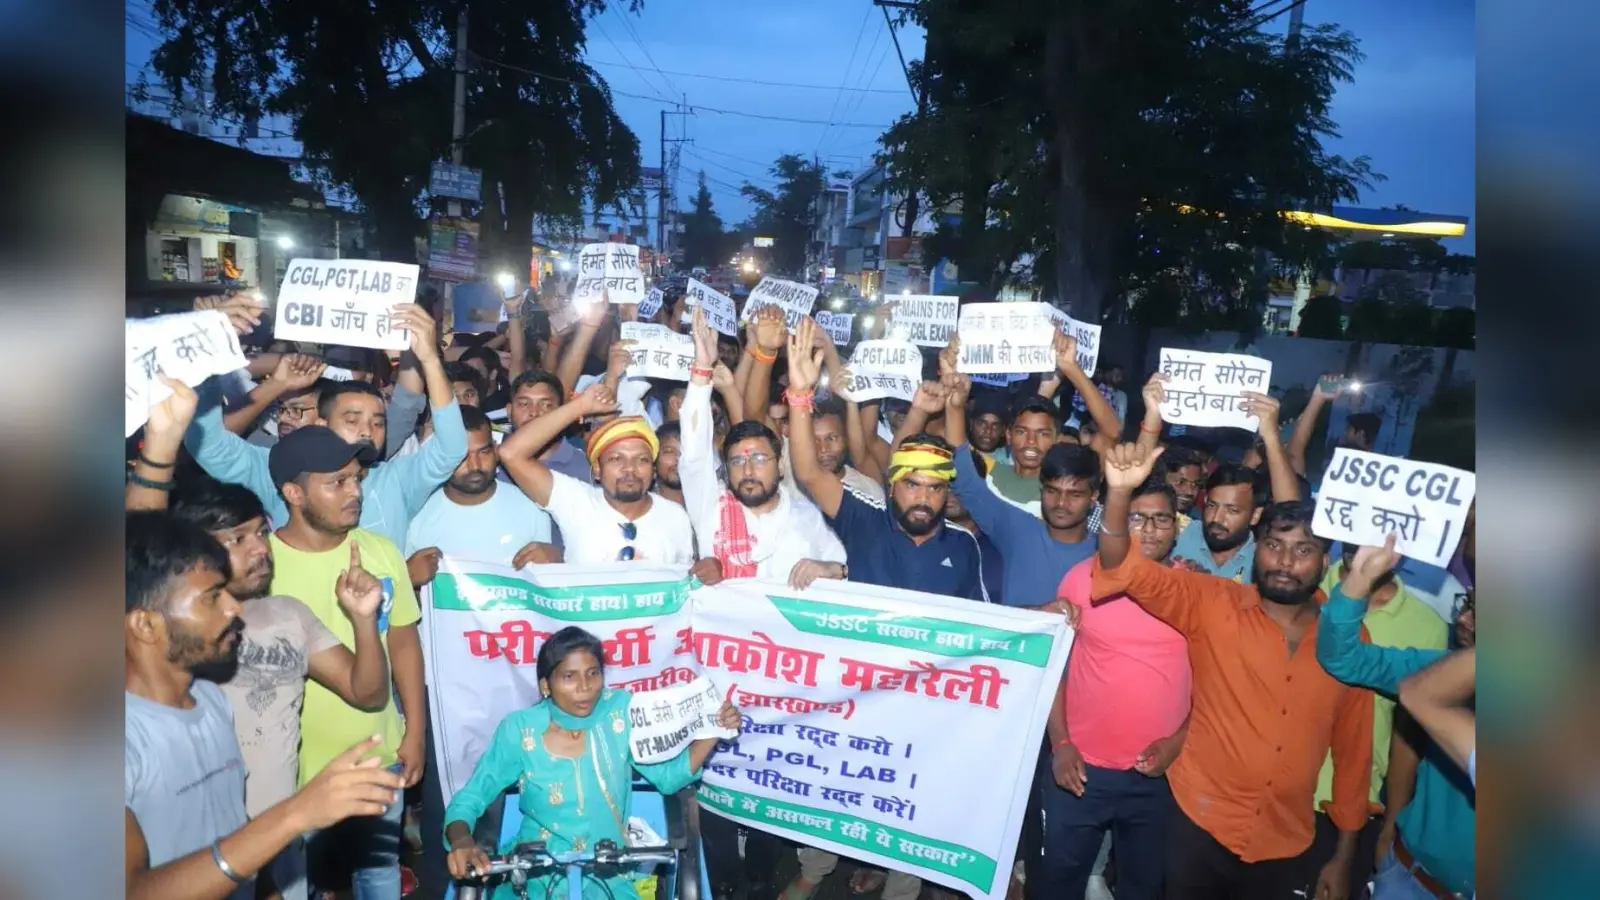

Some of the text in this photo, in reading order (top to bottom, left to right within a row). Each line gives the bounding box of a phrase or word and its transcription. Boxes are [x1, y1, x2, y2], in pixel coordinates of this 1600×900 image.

[289, 265, 392, 296] CGL,PGT,LAB
[756, 279, 814, 310] PT-MAINS FOR
[284, 301, 323, 328] CBI
[936, 301, 956, 320] FOR
[961, 342, 994, 365] JMM
[1162, 354, 1266, 388] हेमंत सोरेन
[1330, 455, 1463, 506] JSSC CGL
[815, 611, 870, 634] JSSC
[876, 621, 929, 643] सरकार
[673, 626, 826, 688] आक्रोश
[838, 656, 1011, 710] महारैली
[635, 726, 689, 759] PT-MAINS
[848, 734, 893, 758] करो
[765, 746, 830, 776] PGL,
[840, 759, 897, 784] LAB
[764, 803, 836, 832] असफल
